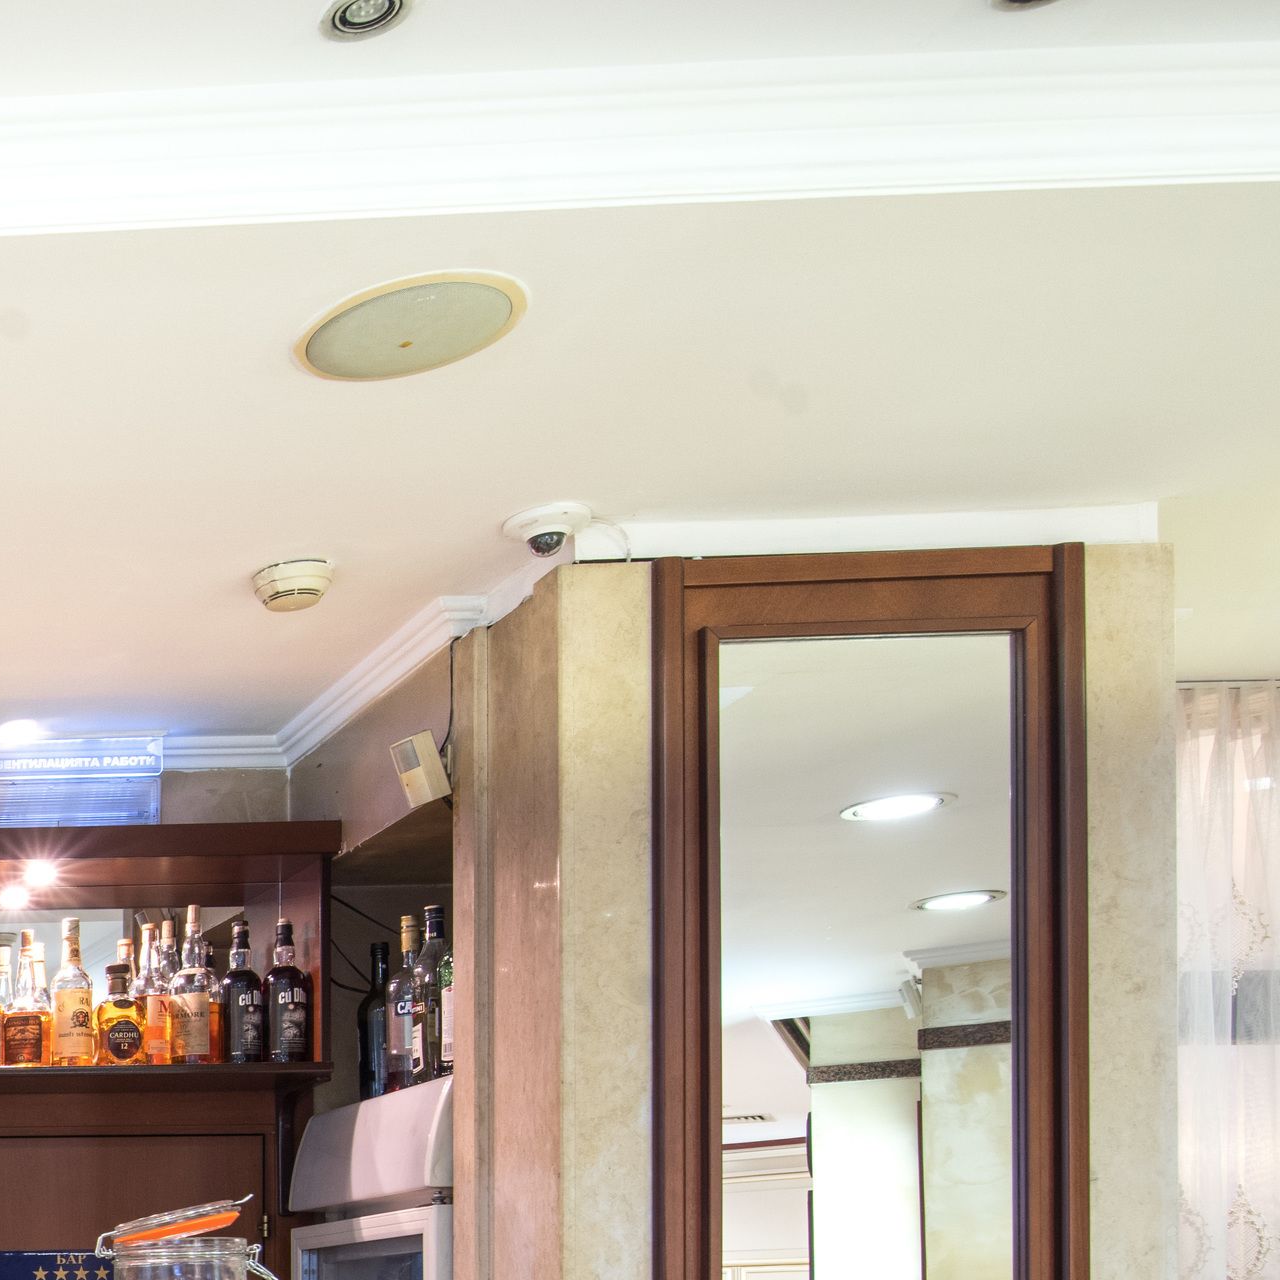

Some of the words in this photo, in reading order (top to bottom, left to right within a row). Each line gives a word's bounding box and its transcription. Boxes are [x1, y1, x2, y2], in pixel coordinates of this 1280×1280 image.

[103, 755, 156, 768] РАБОТИ
[120, 1042, 128, 1050] 12
[56, 1253, 87, 1265] БАР
